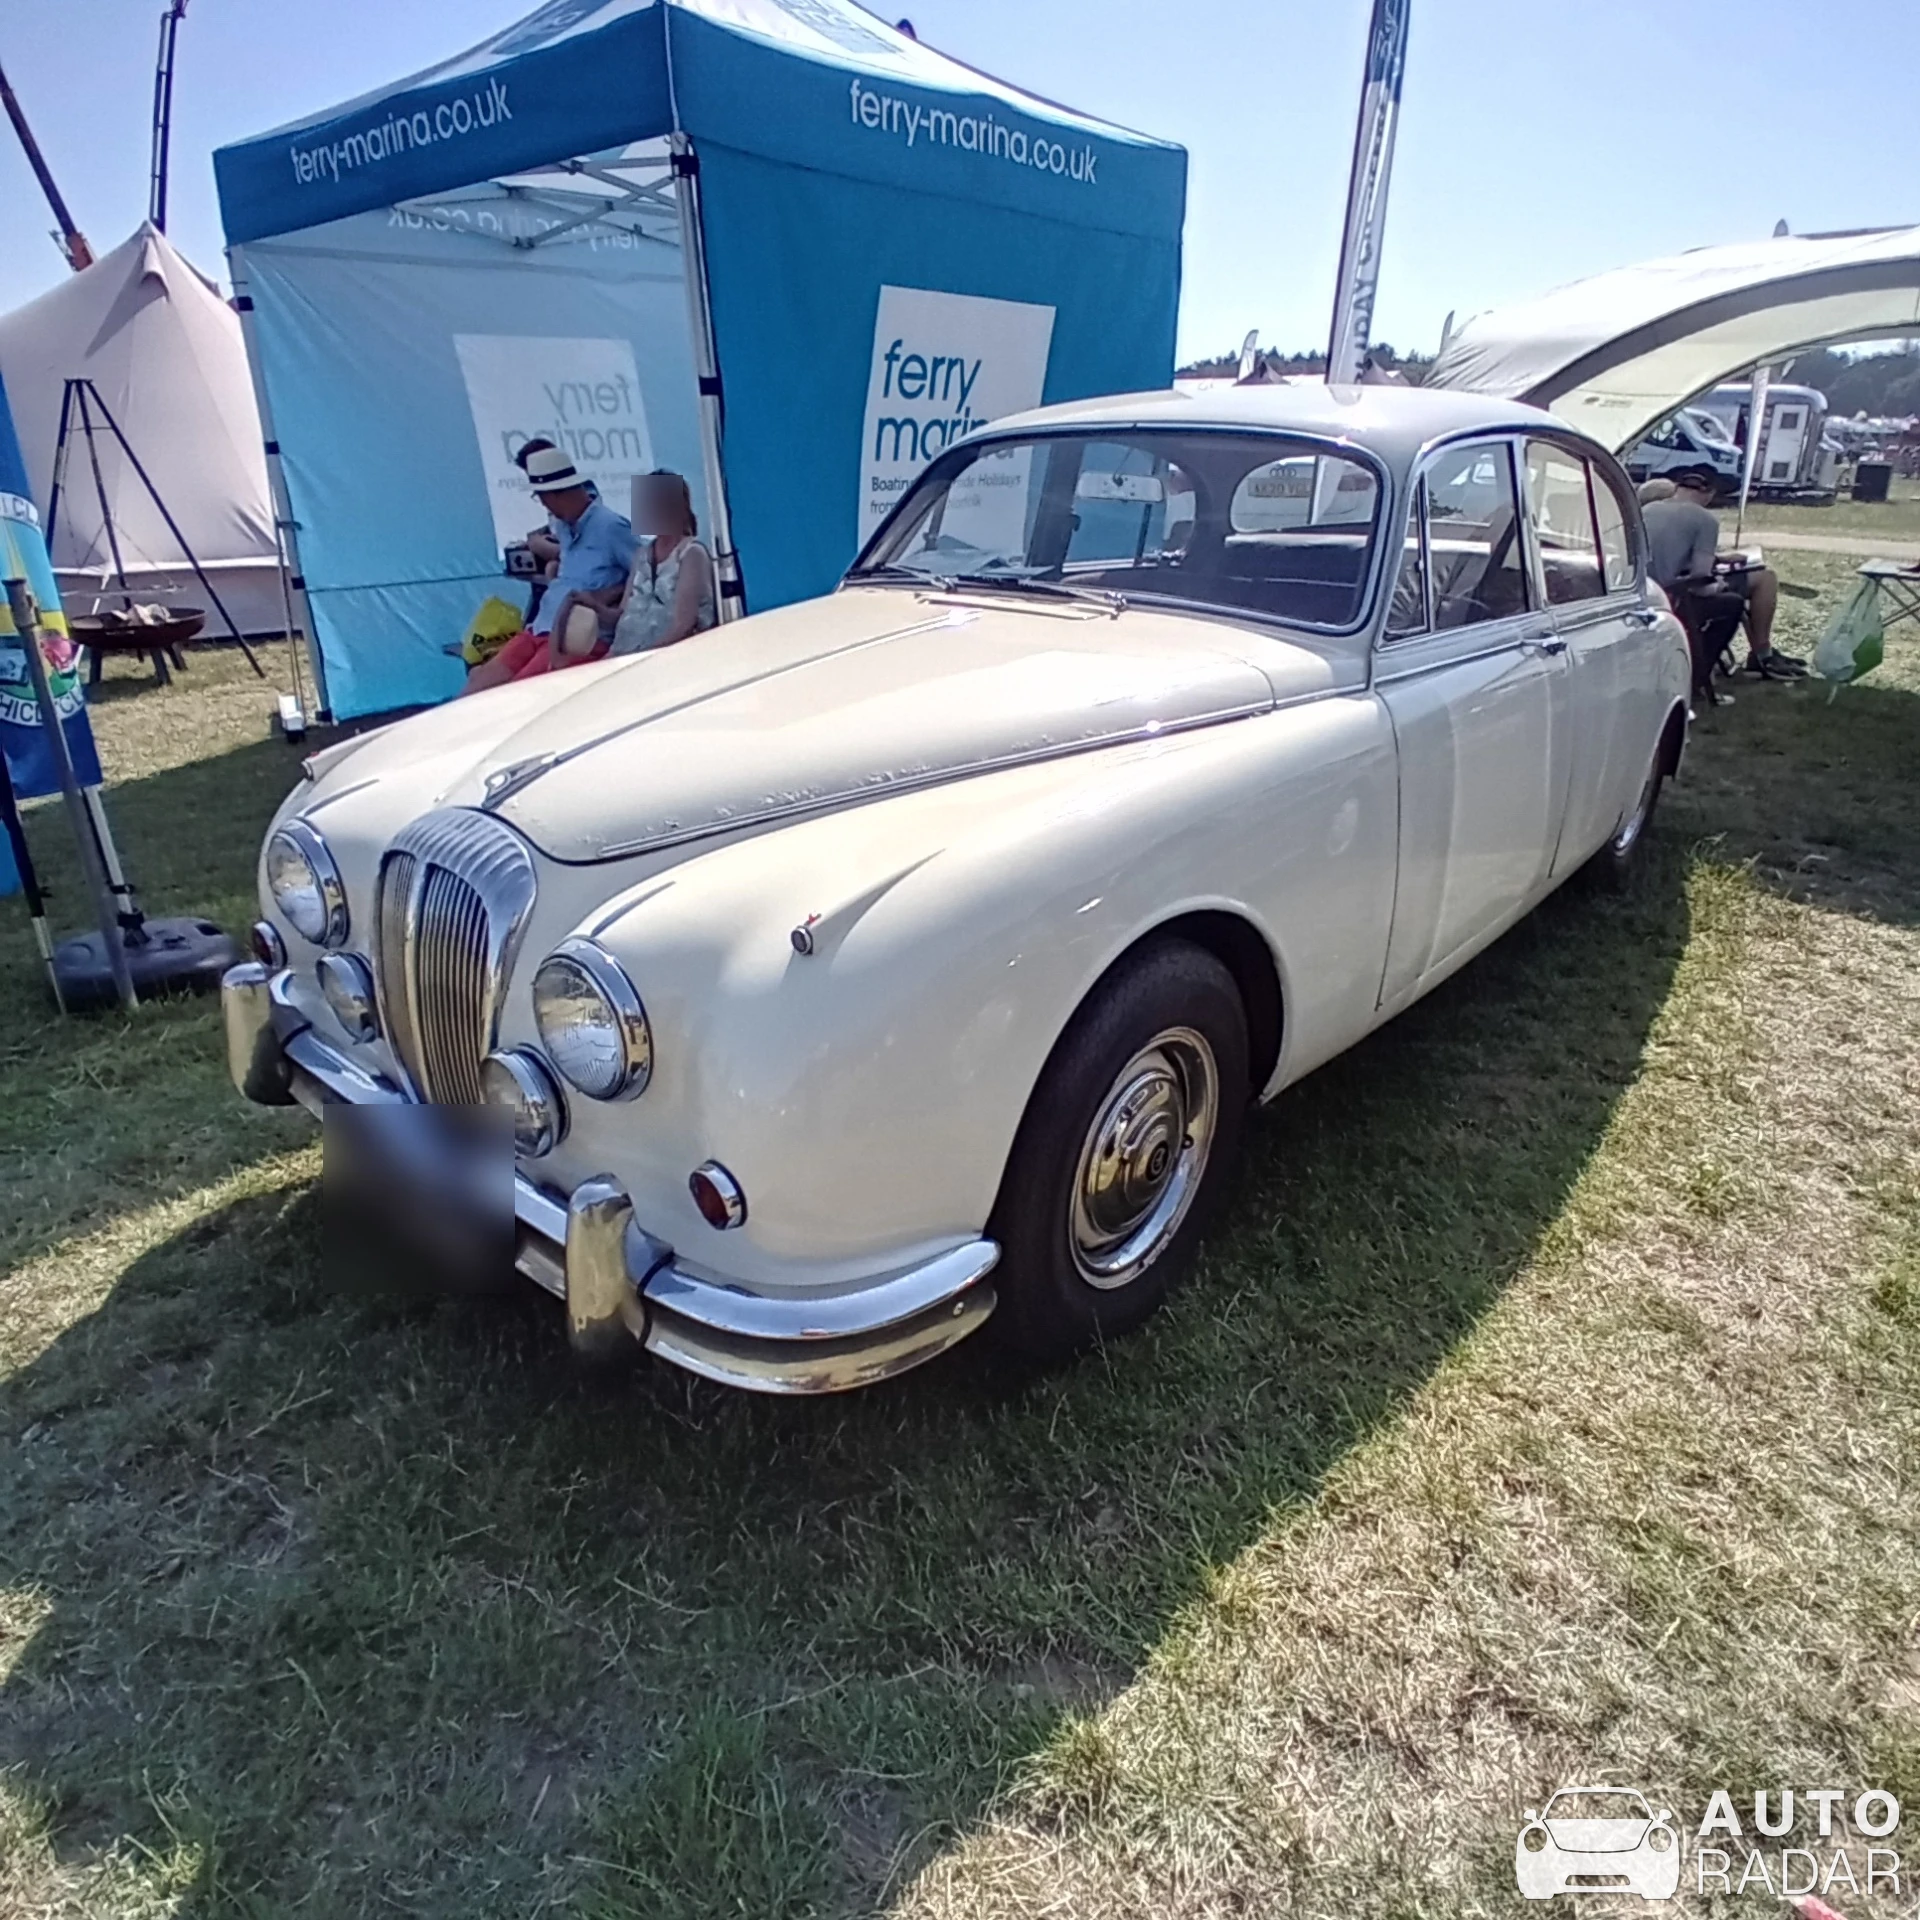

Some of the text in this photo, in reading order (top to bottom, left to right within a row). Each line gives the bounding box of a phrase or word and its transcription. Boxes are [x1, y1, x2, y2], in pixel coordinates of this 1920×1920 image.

[290, 77, 513, 185] ferry-marina.co.uk
[850, 79, 1097, 184] ferry-marina.co.uk
[883, 339, 982, 413] ferry
[875, 407, 1017, 462] mari
